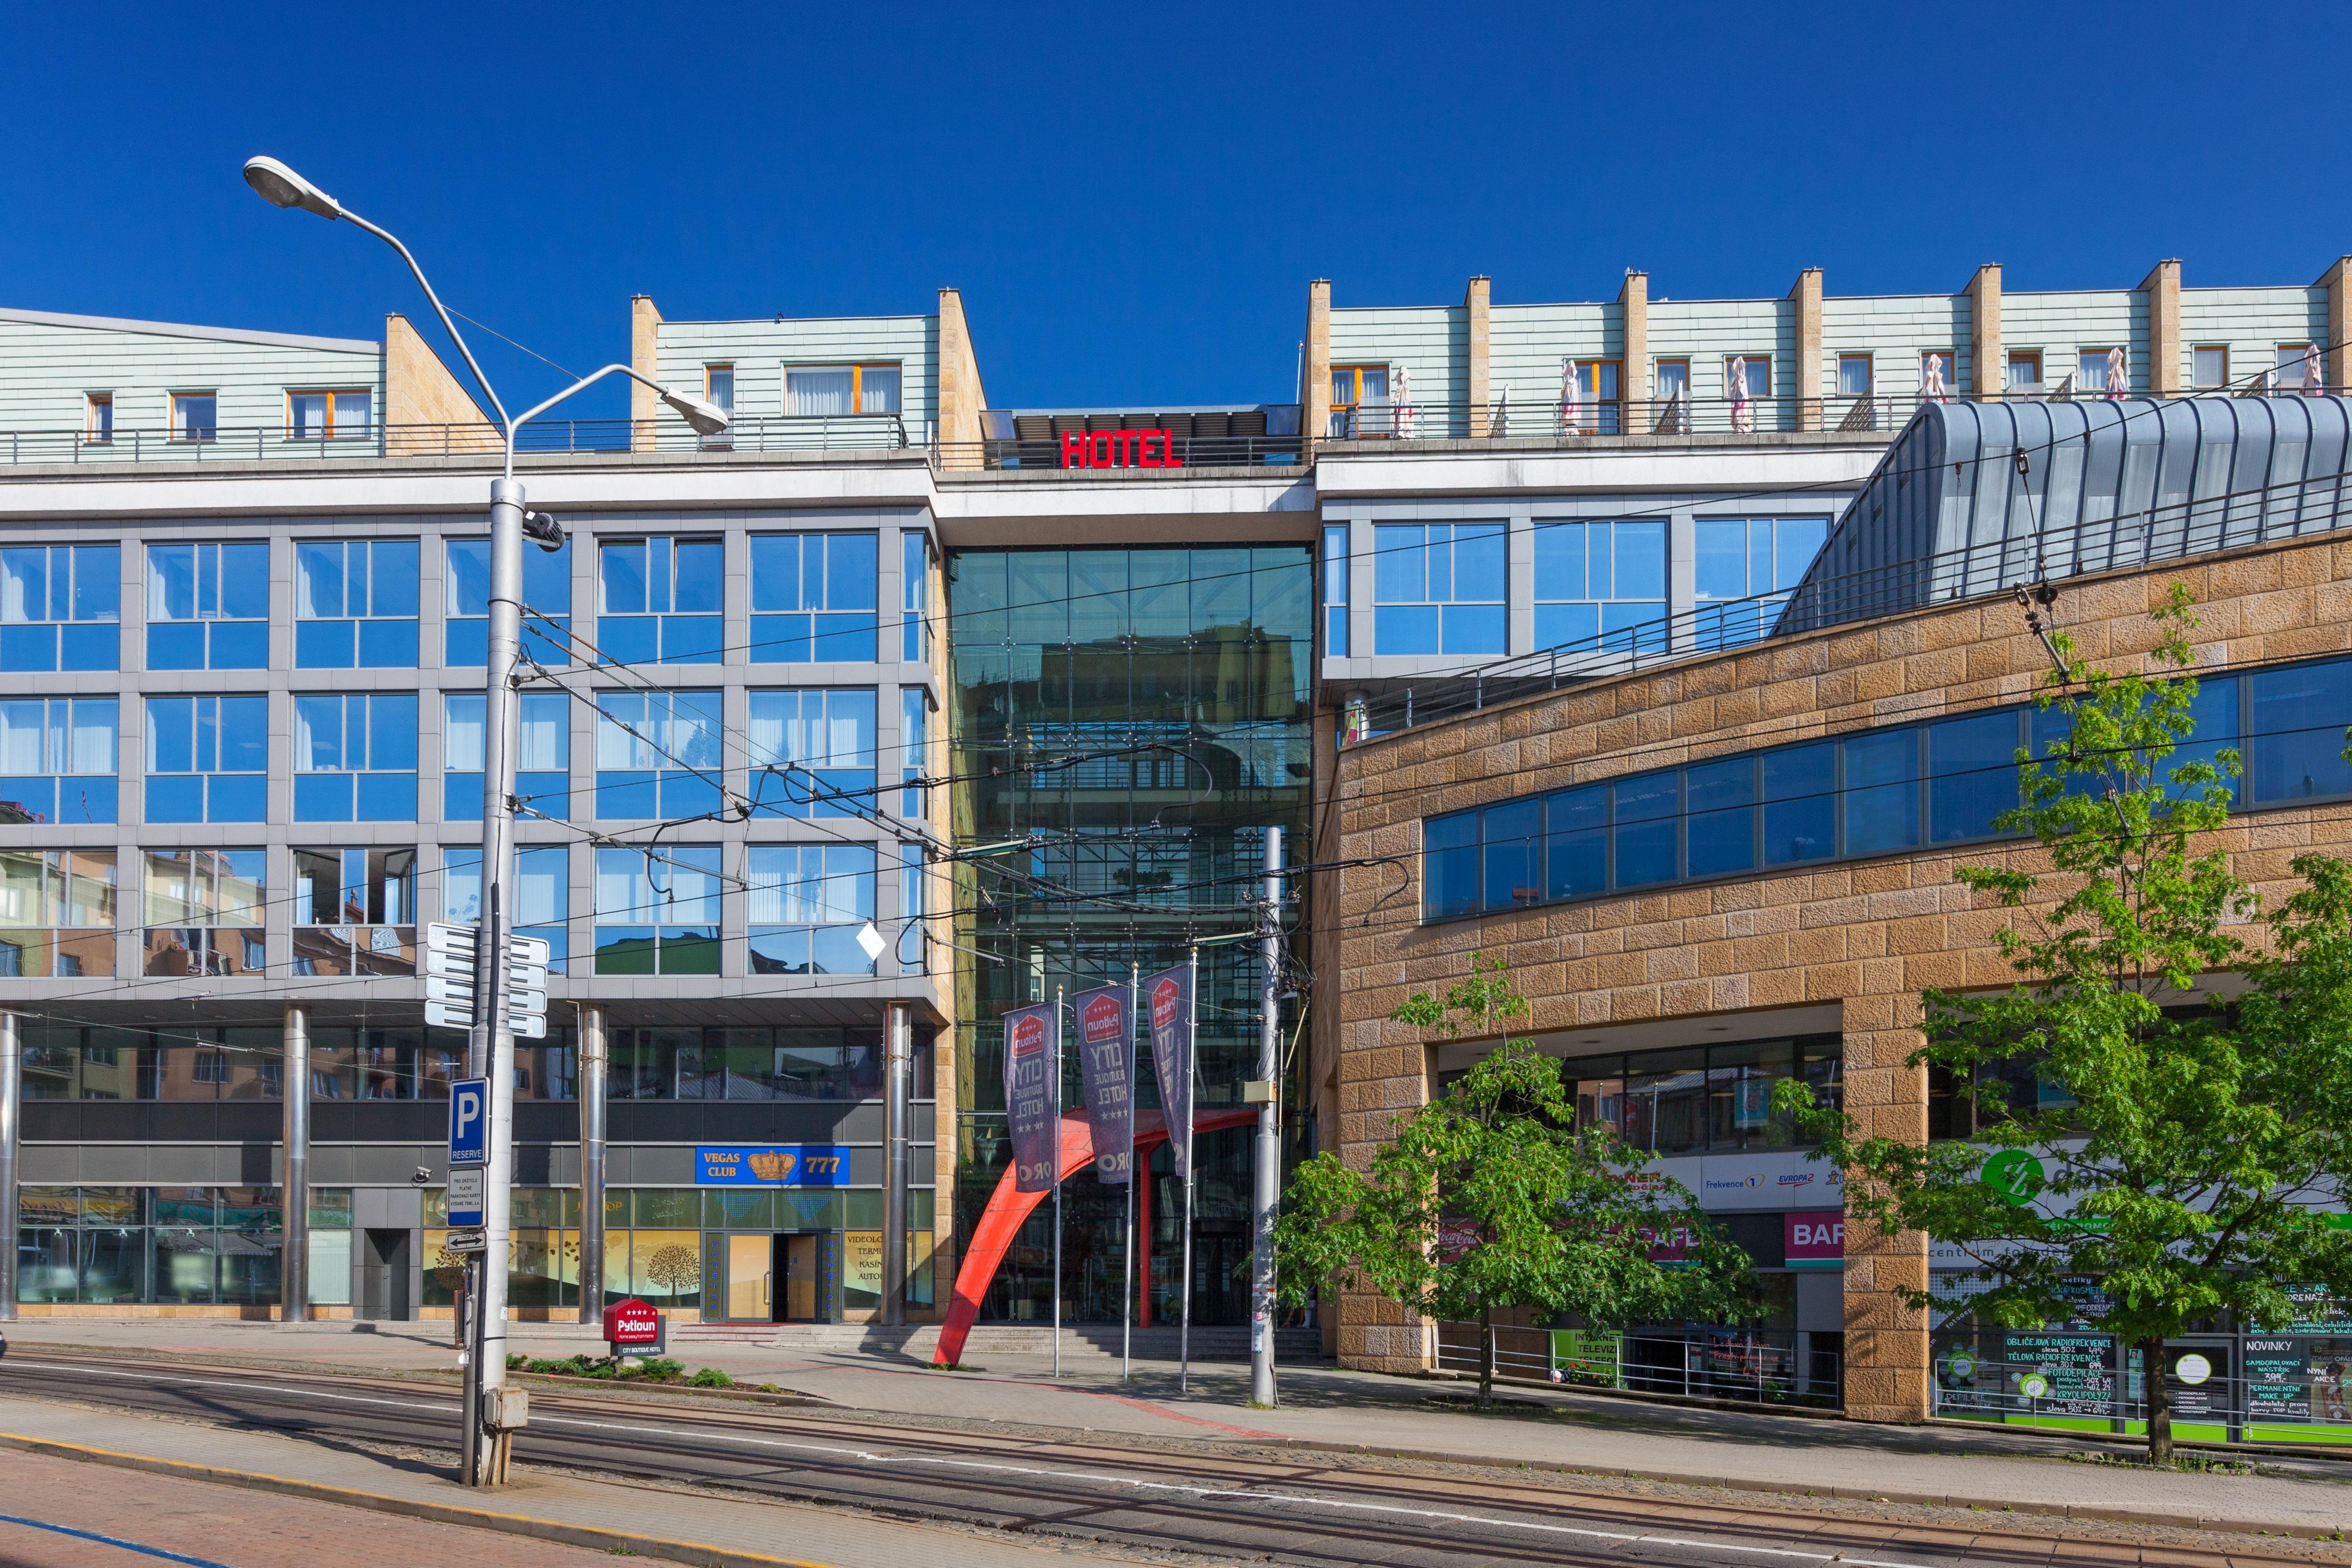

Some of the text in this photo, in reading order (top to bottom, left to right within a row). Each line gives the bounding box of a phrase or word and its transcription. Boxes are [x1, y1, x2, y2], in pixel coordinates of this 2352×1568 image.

[1062, 429, 1182, 469] HOTEL
[458, 1092, 479, 1138] P
[452, 1150, 482, 1159] RESERVE
[704, 1153, 740, 1163] VEGAS
[806, 1157, 840, 1174] 777
[708, 1167, 736, 1177] CLUB
[1706, 1178, 1755, 1188] Frekvence 1
[618, 1320, 655, 1331] Pytloun
[2007, 1337, 2112, 1348] OBLIČEJOVÁ RADIOFREKVENCE
[2246, 1341, 2292, 1351] NOVINKY
[1578, 1345, 1621, 1354] TELEVIZE
[2007, 1351, 2101, 1362] TĚLOVÁ RADIOFREKVENCE
[2048, 1368, 2103, 1378] FOTODEPILACE
[2307, 1366, 2328, 1375] NYNÍ
[2046, 1403, 2066, 1412] sleva
[2288, 1409, 2310, 1417] kvality
